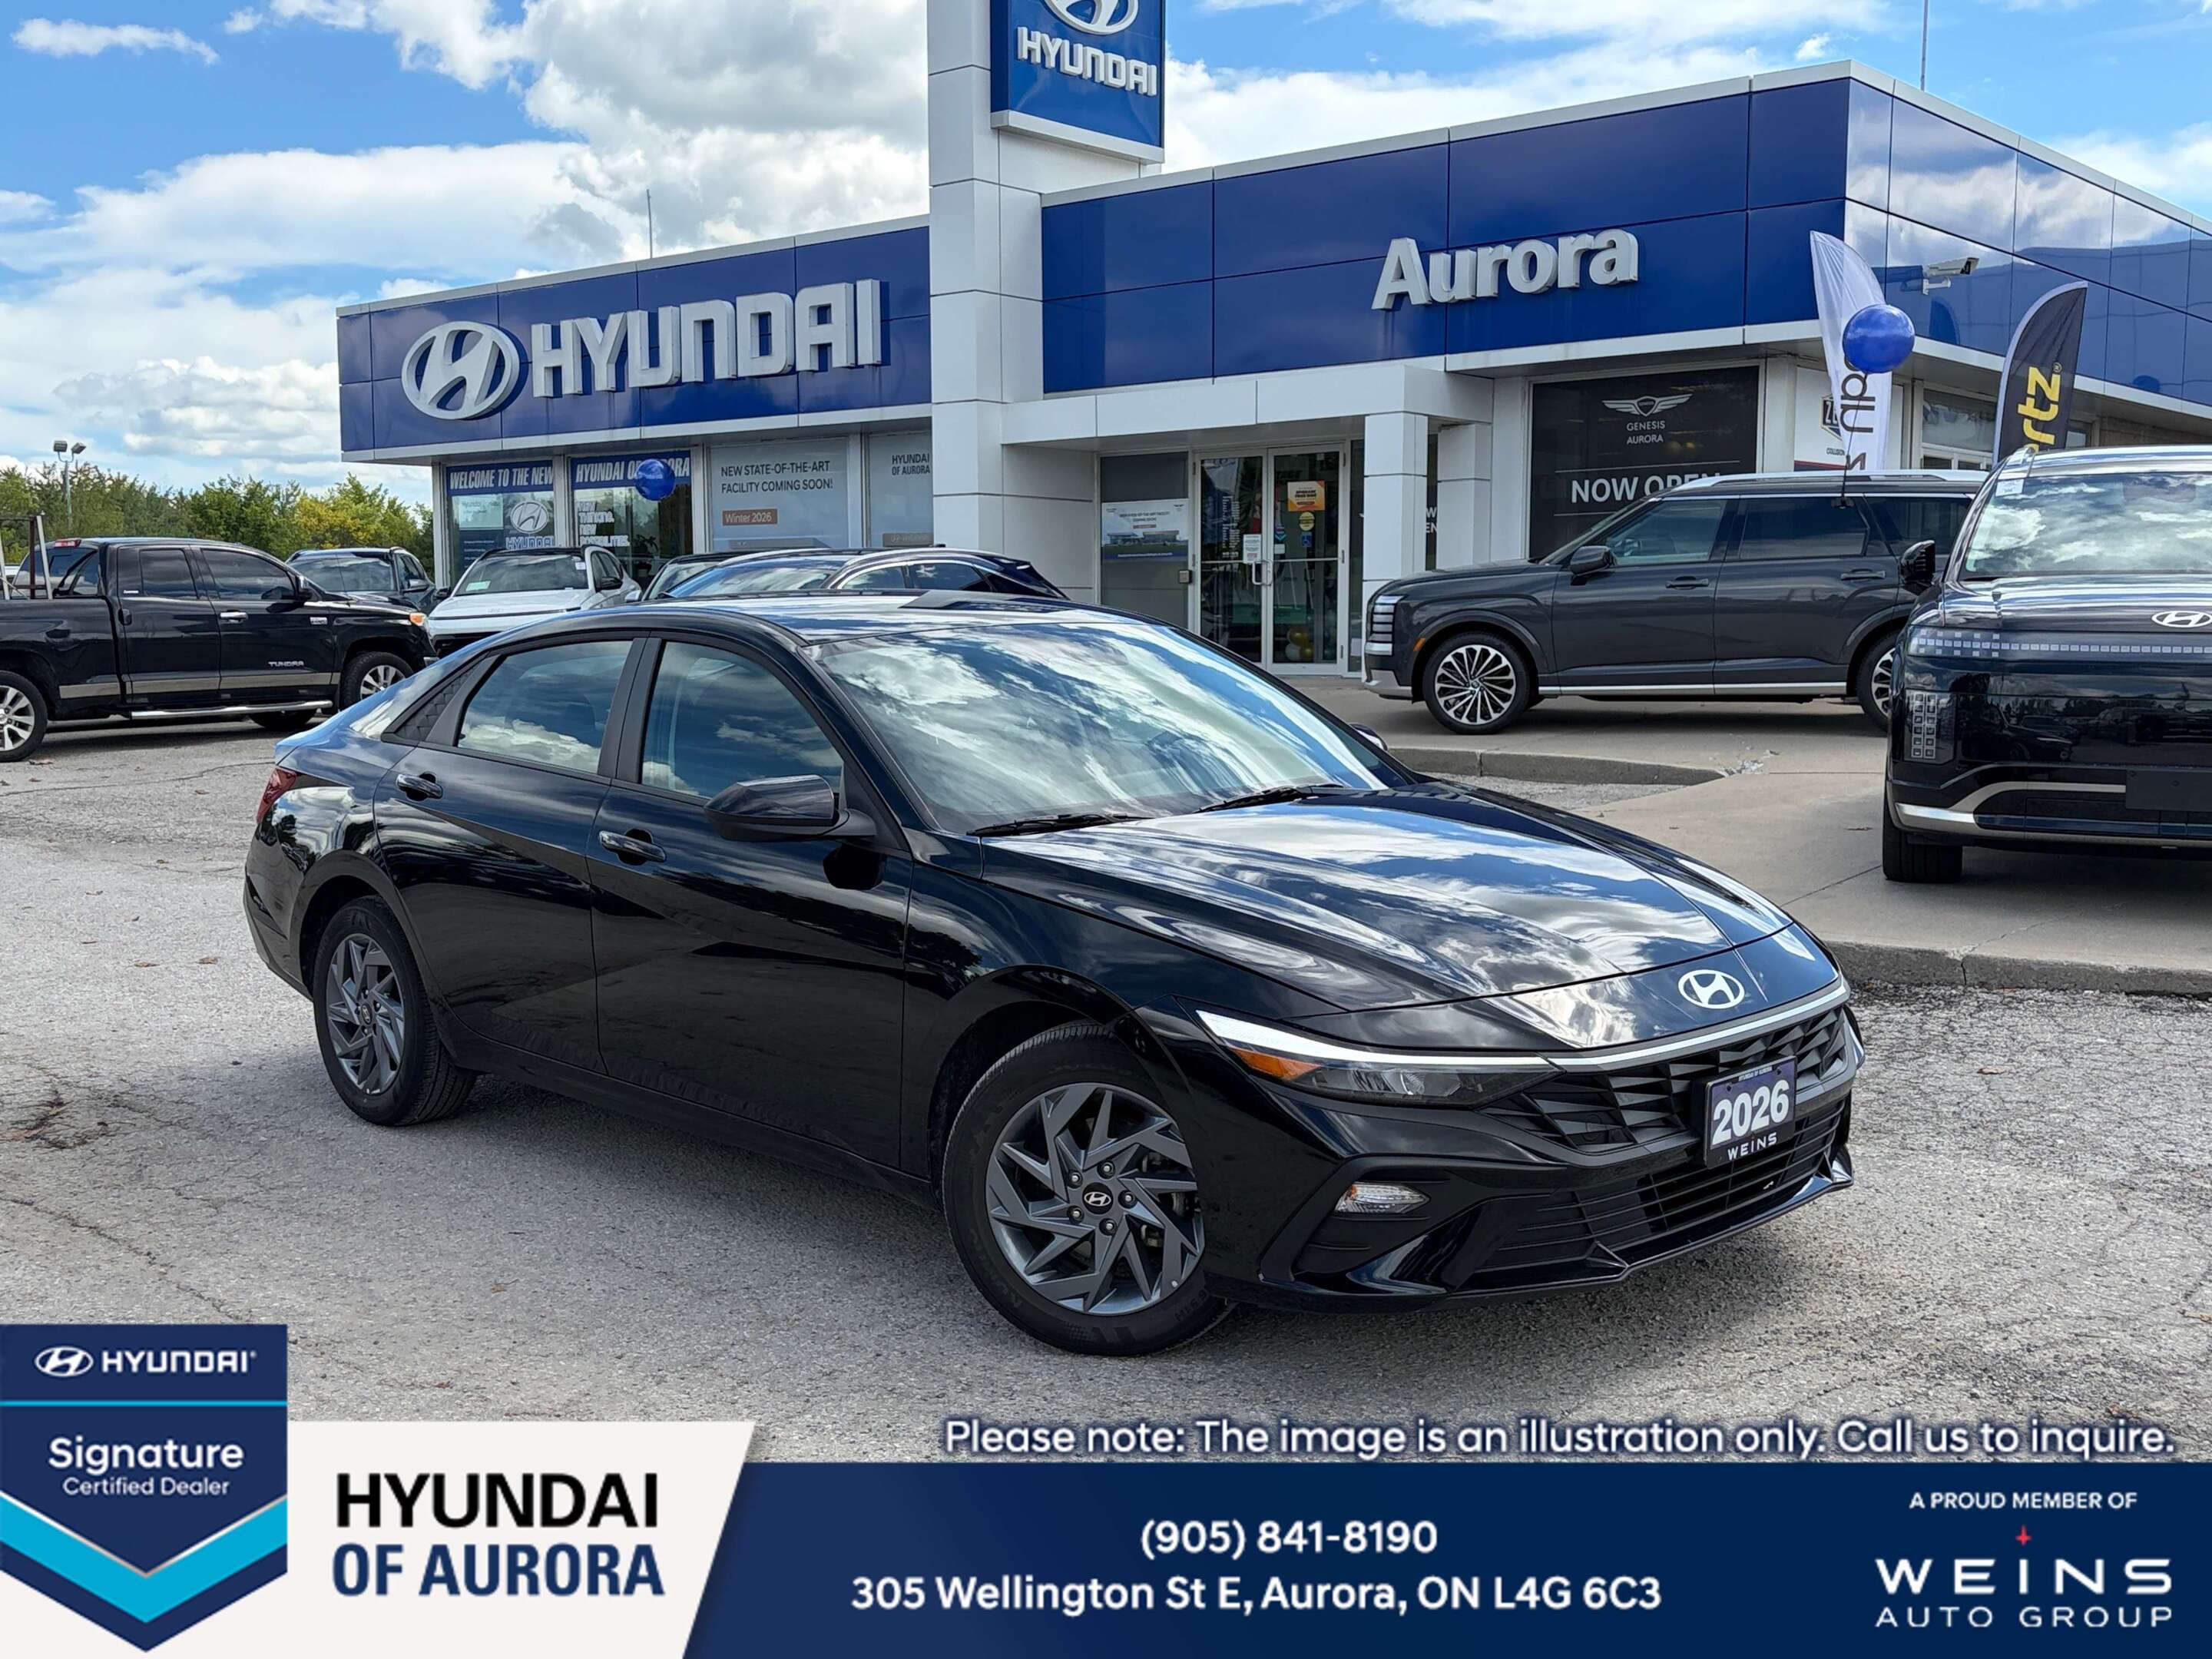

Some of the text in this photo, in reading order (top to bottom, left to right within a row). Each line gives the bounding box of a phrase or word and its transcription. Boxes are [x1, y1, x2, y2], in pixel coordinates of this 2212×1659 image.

[1017, 26, 1157, 97] HYUNDAI
[1371, 228, 1639, 310] Aurora
[531, 279, 882, 398] HYUNDAI
[2018, 366, 2061, 453] rtz
[1627, 421, 1666, 432] GENESIS
[1627, 434, 1664, 445] AURORA
[721, 461, 830, 477] NEW STATE-OF-THE-ART
[892, 453, 930, 465] HYUNDAI
[892, 465, 931, 476] OF AURORA
[450, 466, 554, 490] WELCOME TO THE NEW
[576, 461, 625, 483] HYUNDAI
[721, 478, 833, 494] FACILITY COMING SOON!
[1571, 476, 1639, 503] NOW
[725, 512, 772, 523] Winter 2026
[1711, 1079, 1790, 1146] 2026
[1727, 1132, 1777, 1161] WEINS
